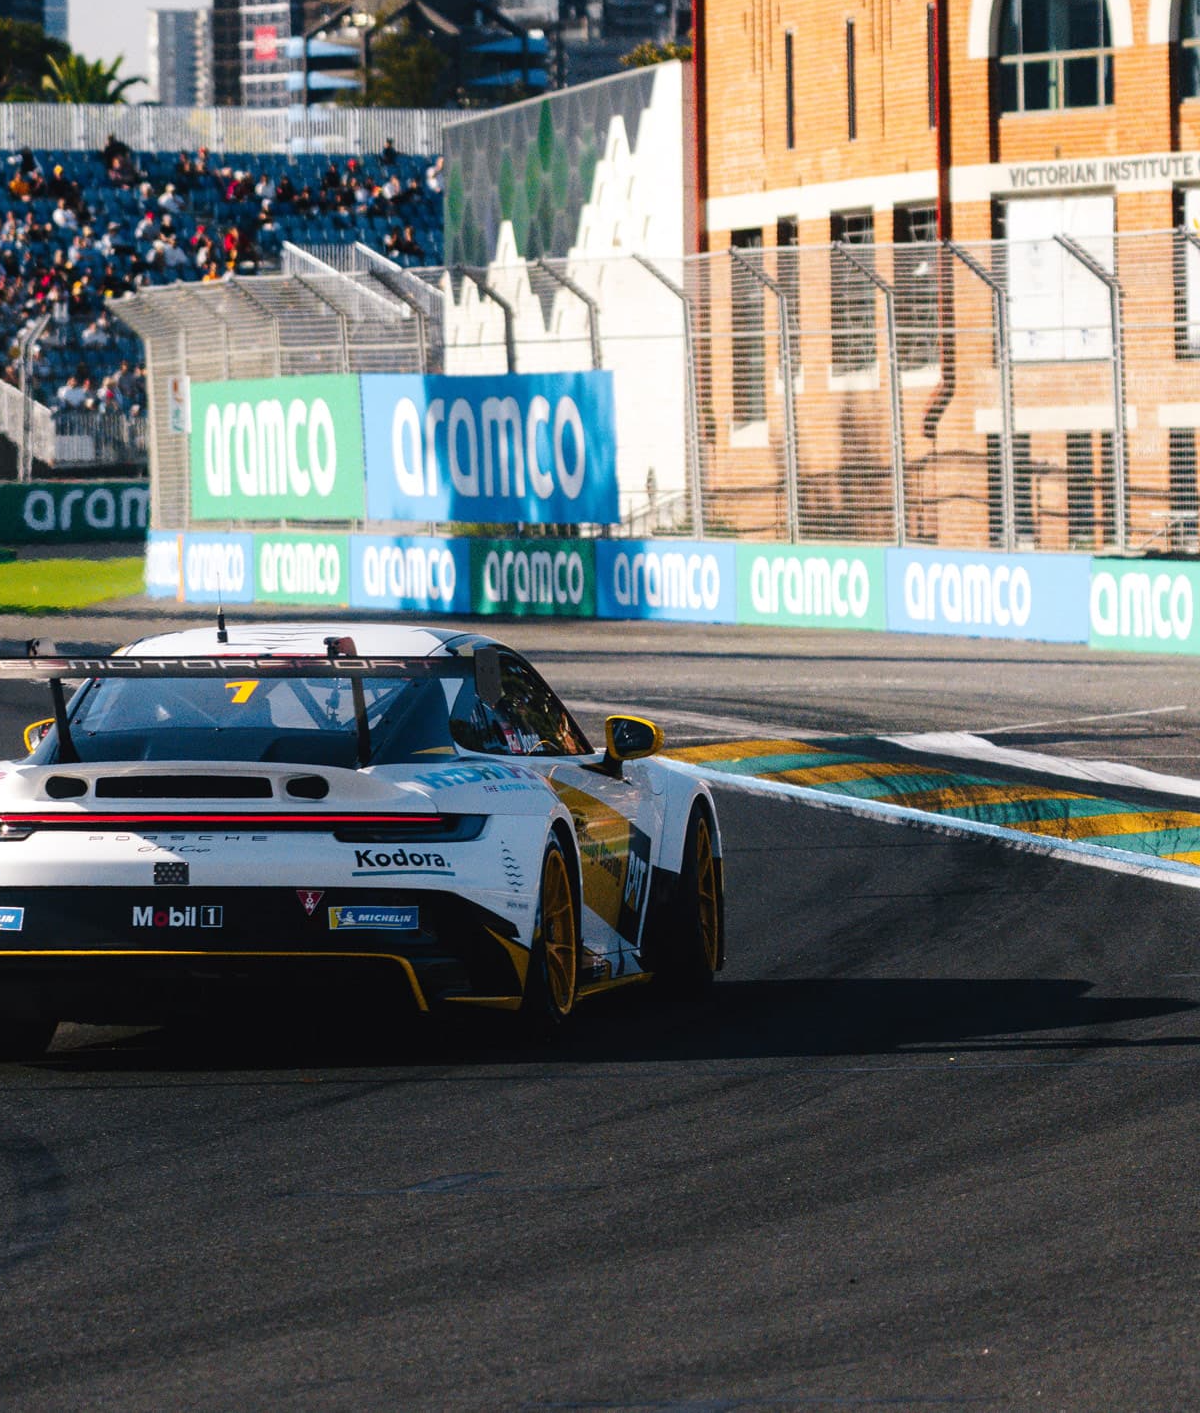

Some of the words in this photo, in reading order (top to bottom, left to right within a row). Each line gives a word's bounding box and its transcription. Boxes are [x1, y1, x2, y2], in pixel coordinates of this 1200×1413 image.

[1009, 162, 1097, 187] VICTORIAN
[1103, 157, 1193, 181] INSTITUTE
[204, 397, 338, 497] aramco
[390, 394, 586, 500] aramco
[186, 543, 245, 591] aramco
[260, 542, 341, 596] aramco
[362, 545, 456, 602] aramco
[485, 550, 584, 605] aramco
[613, 551, 720, 611] aramco
[751, 556, 870, 618] aramco
[904, 561, 1032, 627] aramco
[132, 906, 197, 927] Mobil
[306, 892, 315, 910] TOW
[358, 913, 413, 924] MICHELIN
